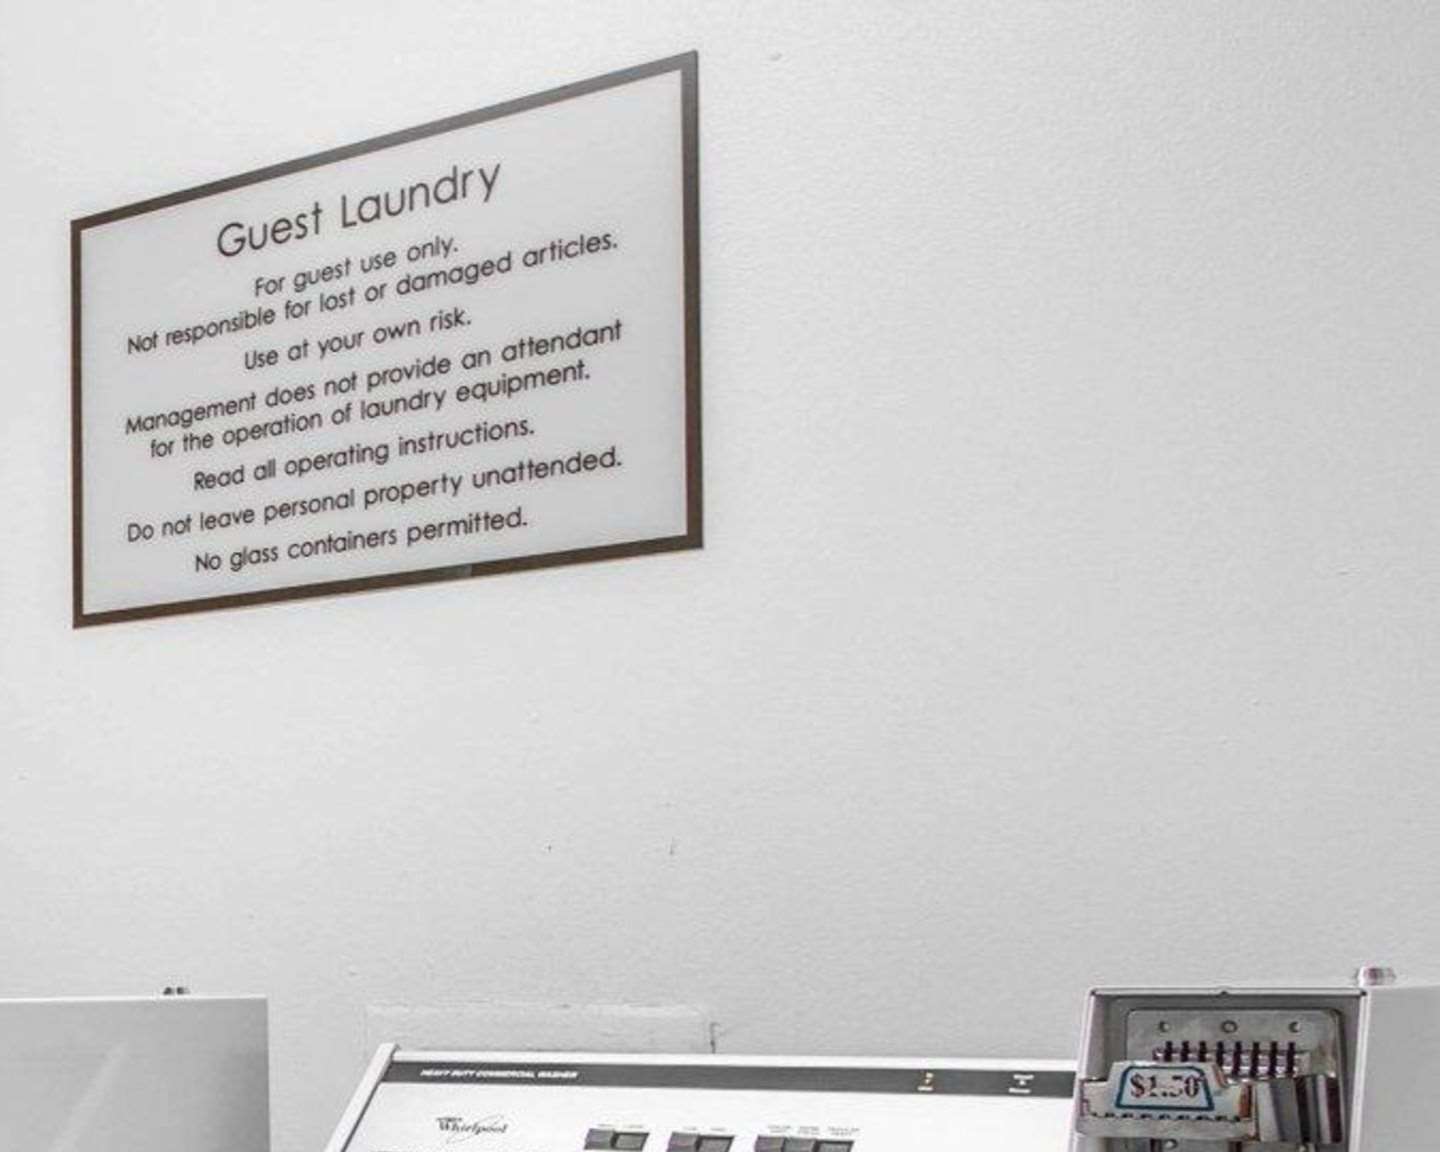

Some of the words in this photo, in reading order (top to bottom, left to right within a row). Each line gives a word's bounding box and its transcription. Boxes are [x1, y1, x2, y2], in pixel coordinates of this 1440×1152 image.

[216, 201, 324, 258] Guest
[340, 163, 501, 230] Laundry
[127, 330, 160, 355] Not
[165, 306, 277, 347] responsible
[284, 299, 313, 321] for
[319, 285, 356, 313] lost
[363, 282, 388, 303] or
[395, 250, 513, 296] damaged
[522, 232, 618, 268] articles.
[254, 276, 287, 298] For
[292, 257, 352, 294] guest
[359, 250, 398, 274] use
[406, 235, 459, 263] only.
[124, 391, 257, 436] Management
[264, 383, 317, 409] does
[323, 370, 358, 397] not
[366, 354, 453, 394] provide
[460, 349, 492, 371] an
[500, 318, 623, 363] attendant
[244, 349, 280, 371] Use
[287, 338, 310, 362] at
[316, 330, 366, 361] your
[372, 318, 422, 345] own
[429, 306, 472, 333] risk.
[150, 438, 176, 459] for
[181, 431, 215, 453] the
[221, 412, 324, 448] operation
[330, 401, 353, 426] of
[359, 388, 448, 421] laundry
[455, 358, 591, 404] equipment.
[127, 522, 155, 543] Do
[161, 513, 193, 537] not
[199, 508, 256, 532] leave
[263, 487, 356, 526] personal
[363, 472, 464, 511] property
[471, 445, 623, 490] unattended.
[193, 463, 246, 492] Read
[253, 457, 277, 482] all
[283, 442, 390, 478] operating
[397, 418, 535, 457] instructions.
[194, 551, 223, 573] No
[229, 545, 279, 573] glass
[287, 528, 398, 560] containers
[406, 505, 528, 548] permitted.
[438, 1118, 509, 1136] Whirlpool
